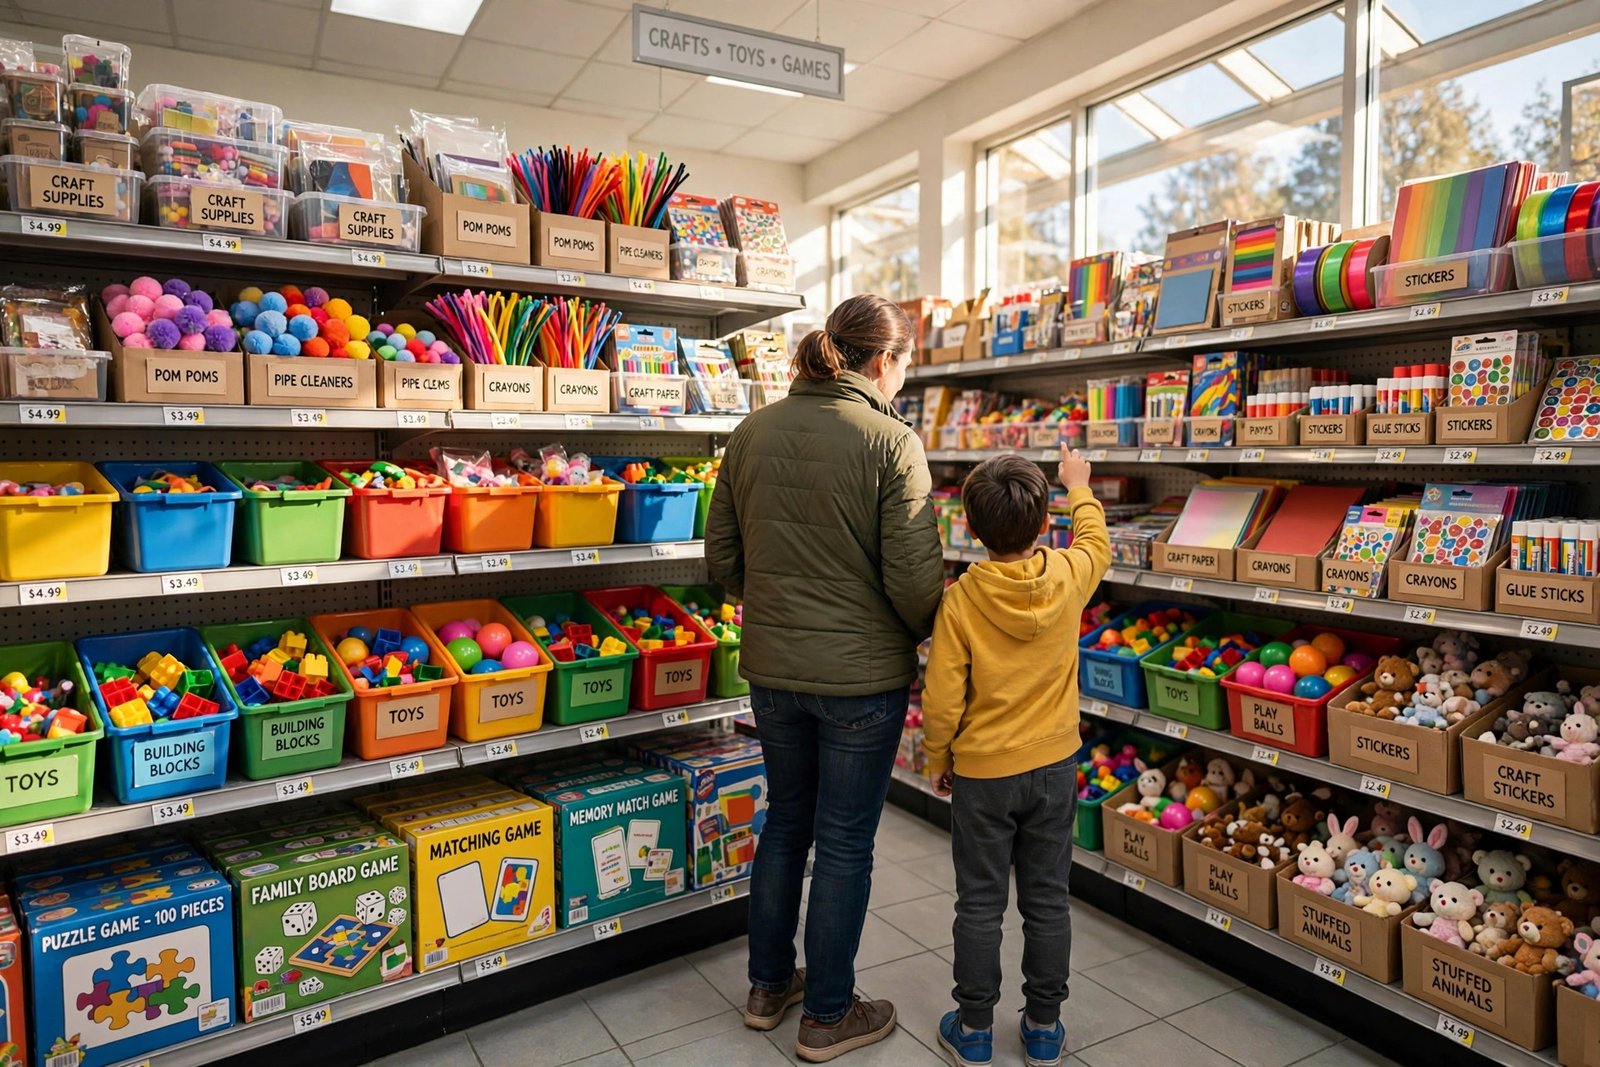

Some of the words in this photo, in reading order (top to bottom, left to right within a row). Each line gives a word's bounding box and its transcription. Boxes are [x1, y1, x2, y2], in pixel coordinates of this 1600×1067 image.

[648, 28, 709, 56] CRAFTS
[727, 43, 765, 67] TOYS
[782, 54, 831, 81] GAMES
[52, 175, 94, 191] CRAFT
[43, 190, 104, 209] SUPPLIES
[208, 194, 245, 209] CRAFT
[201, 208, 254, 225] SUPPLIES
[353, 211, 386, 225] CRAFT
[29, 220, 62, 233] $4.99
[347, 223, 394, 240] SUPPLIES
[463, 220, 485, 233] POM
[487, 222, 511, 237] POMS
[209, 239, 237, 250] $4.99
[554, 237, 572, 249] POM
[573, 238, 595, 251] POMS
[357, 254, 381, 264] $4.99
[466, 264, 489, 274] $3.49
[1405, 269, 1454, 287] STICKERS
[155, 368, 181, 382] POM
[186, 370, 218, 383] POMS
[274, 373, 297, 387] PIPE
[301, 374, 353, 388] CLEANERS
[402, 377, 420, 390] PIPE
[489, 381, 531, 394] CRAYONS
[560, 383, 598, 396] CRAYONS
[629, 387, 655, 399] CRAFT
[656, 387, 680, 400] PAPER
[28, 408, 60, 420] $4.99
[171, 410, 199, 422] $3.49
[297, 412, 323, 423] $3.49
[402, 413, 426, 424] $3.49
[1308, 424, 1343, 435] STICKERS
[1372, 423, 1393, 434] GLUE
[1394, 423, 1421, 434] STICKS
[1447, 419, 1492, 432] STICKERS
[1448, 450, 1472, 462] $2.49
[486, 557, 508, 568] $2.49
[576, 551, 596, 562] $3.49
[1167, 551, 1191, 565] CRAFT
[1192, 553, 1215, 568] PAPER
[287, 569, 314, 581] $3.49
[394, 562, 418, 574] $3.49
[1252, 560, 1291, 574] CRAYONS
[1326, 567, 1369, 583] CRAYONS
[169, 577, 198, 589] $3.49
[1405, 574, 1457, 590] CRAYONS
[29, 586, 61, 599] $4.99
[1506, 583, 1537, 599] GLUE
[1540, 586, 1584, 603] STICKS
[1526, 625, 1553, 637] $2.49
[665, 669, 692, 684] TOYS
[583, 679, 613, 695] TOYS
[1165, 685, 1188, 702] TOYS
[492, 691, 524, 709] TOYS
[389, 706, 425, 724] TOYS
[1254, 703, 1277, 719] PLAY
[271, 716, 324, 736] BUILDING
[585, 727, 605, 738] $2.49
[1253, 718, 1283, 736] BALLS
[144, 739, 205, 761] BUILDING
[276, 733, 320, 752] BLOCKS
[491, 743, 513, 755] $2.49
[1357, 736, 1410, 760] STICKERS
[150, 757, 200, 777] BLOCKS
[395, 761, 419, 774] $5.49
[6, 770, 59, 793] TOYS
[1498, 765, 1540, 787] CRAFT
[282, 782, 310, 795] $3.49
[1364, 779, 1387, 792] $2.49
[1493, 781, 1554, 809] STICKERS
[160, 803, 189, 818] $3.49
[570, 804, 613, 826] MEMORY
[617, 795, 649, 816] MATCH
[653, 789, 678, 807] GAME
[1500, 820, 1528, 833] $2.49
[14, 830, 48, 846] $3.49
[430, 831, 501, 861] MATCHING
[505, 821, 542, 843] GAME
[1124, 829, 1145, 846] PLAY
[1123, 841, 1150, 862] BALLS
[251, 878, 303, 905] FAMILY
[309, 866, 356, 890] BOARD
[361, 855, 398, 880] GAME
[1210, 864, 1233, 883] PLAY
[1209, 879, 1239, 901] BALLS
[42, 930, 96, 952] PUZZLE
[100, 919, 140, 939] GAME
[155, 908, 177, 925] 100
[181, 896, 224, 919] PIECES
[1302, 905, 1351, 935] STUFFED
[1302, 922, 1352, 953] ANIMALS
[480, 956, 503, 971] $5.49
[1432, 958, 1492, 993] STUFFED
[1432, 976, 1493, 1013] ANIMALS
[300, 1010, 327, 1026] $5.49
[1443, 1019, 1469, 1040] $4.99
